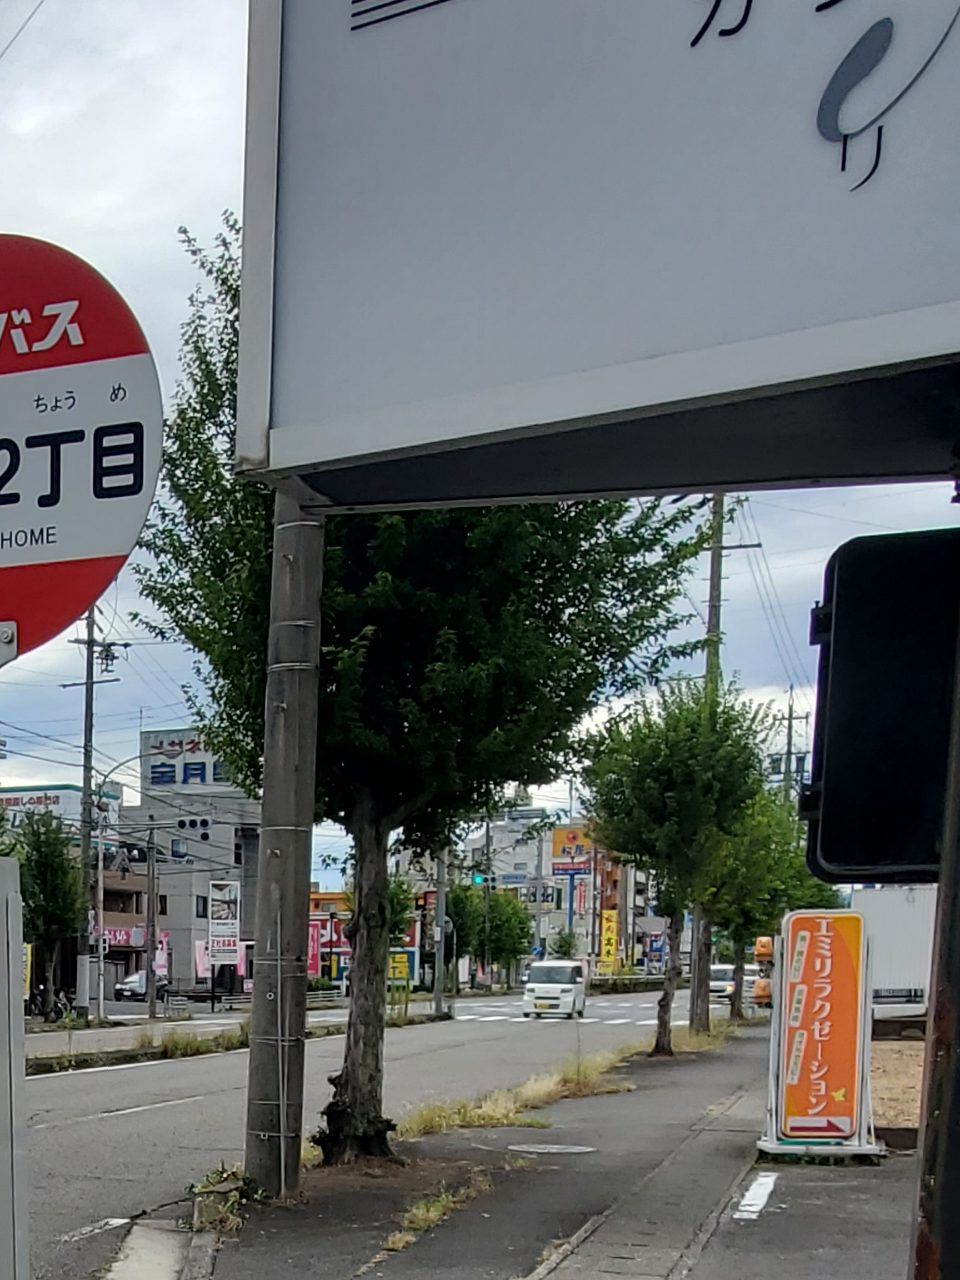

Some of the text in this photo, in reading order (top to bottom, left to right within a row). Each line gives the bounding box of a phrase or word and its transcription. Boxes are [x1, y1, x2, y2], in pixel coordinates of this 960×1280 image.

[33, 390, 77, 414] ちょう
[109, 384, 127, 403] め
[807, 918, 834, 1115] エミリラクゼーション
